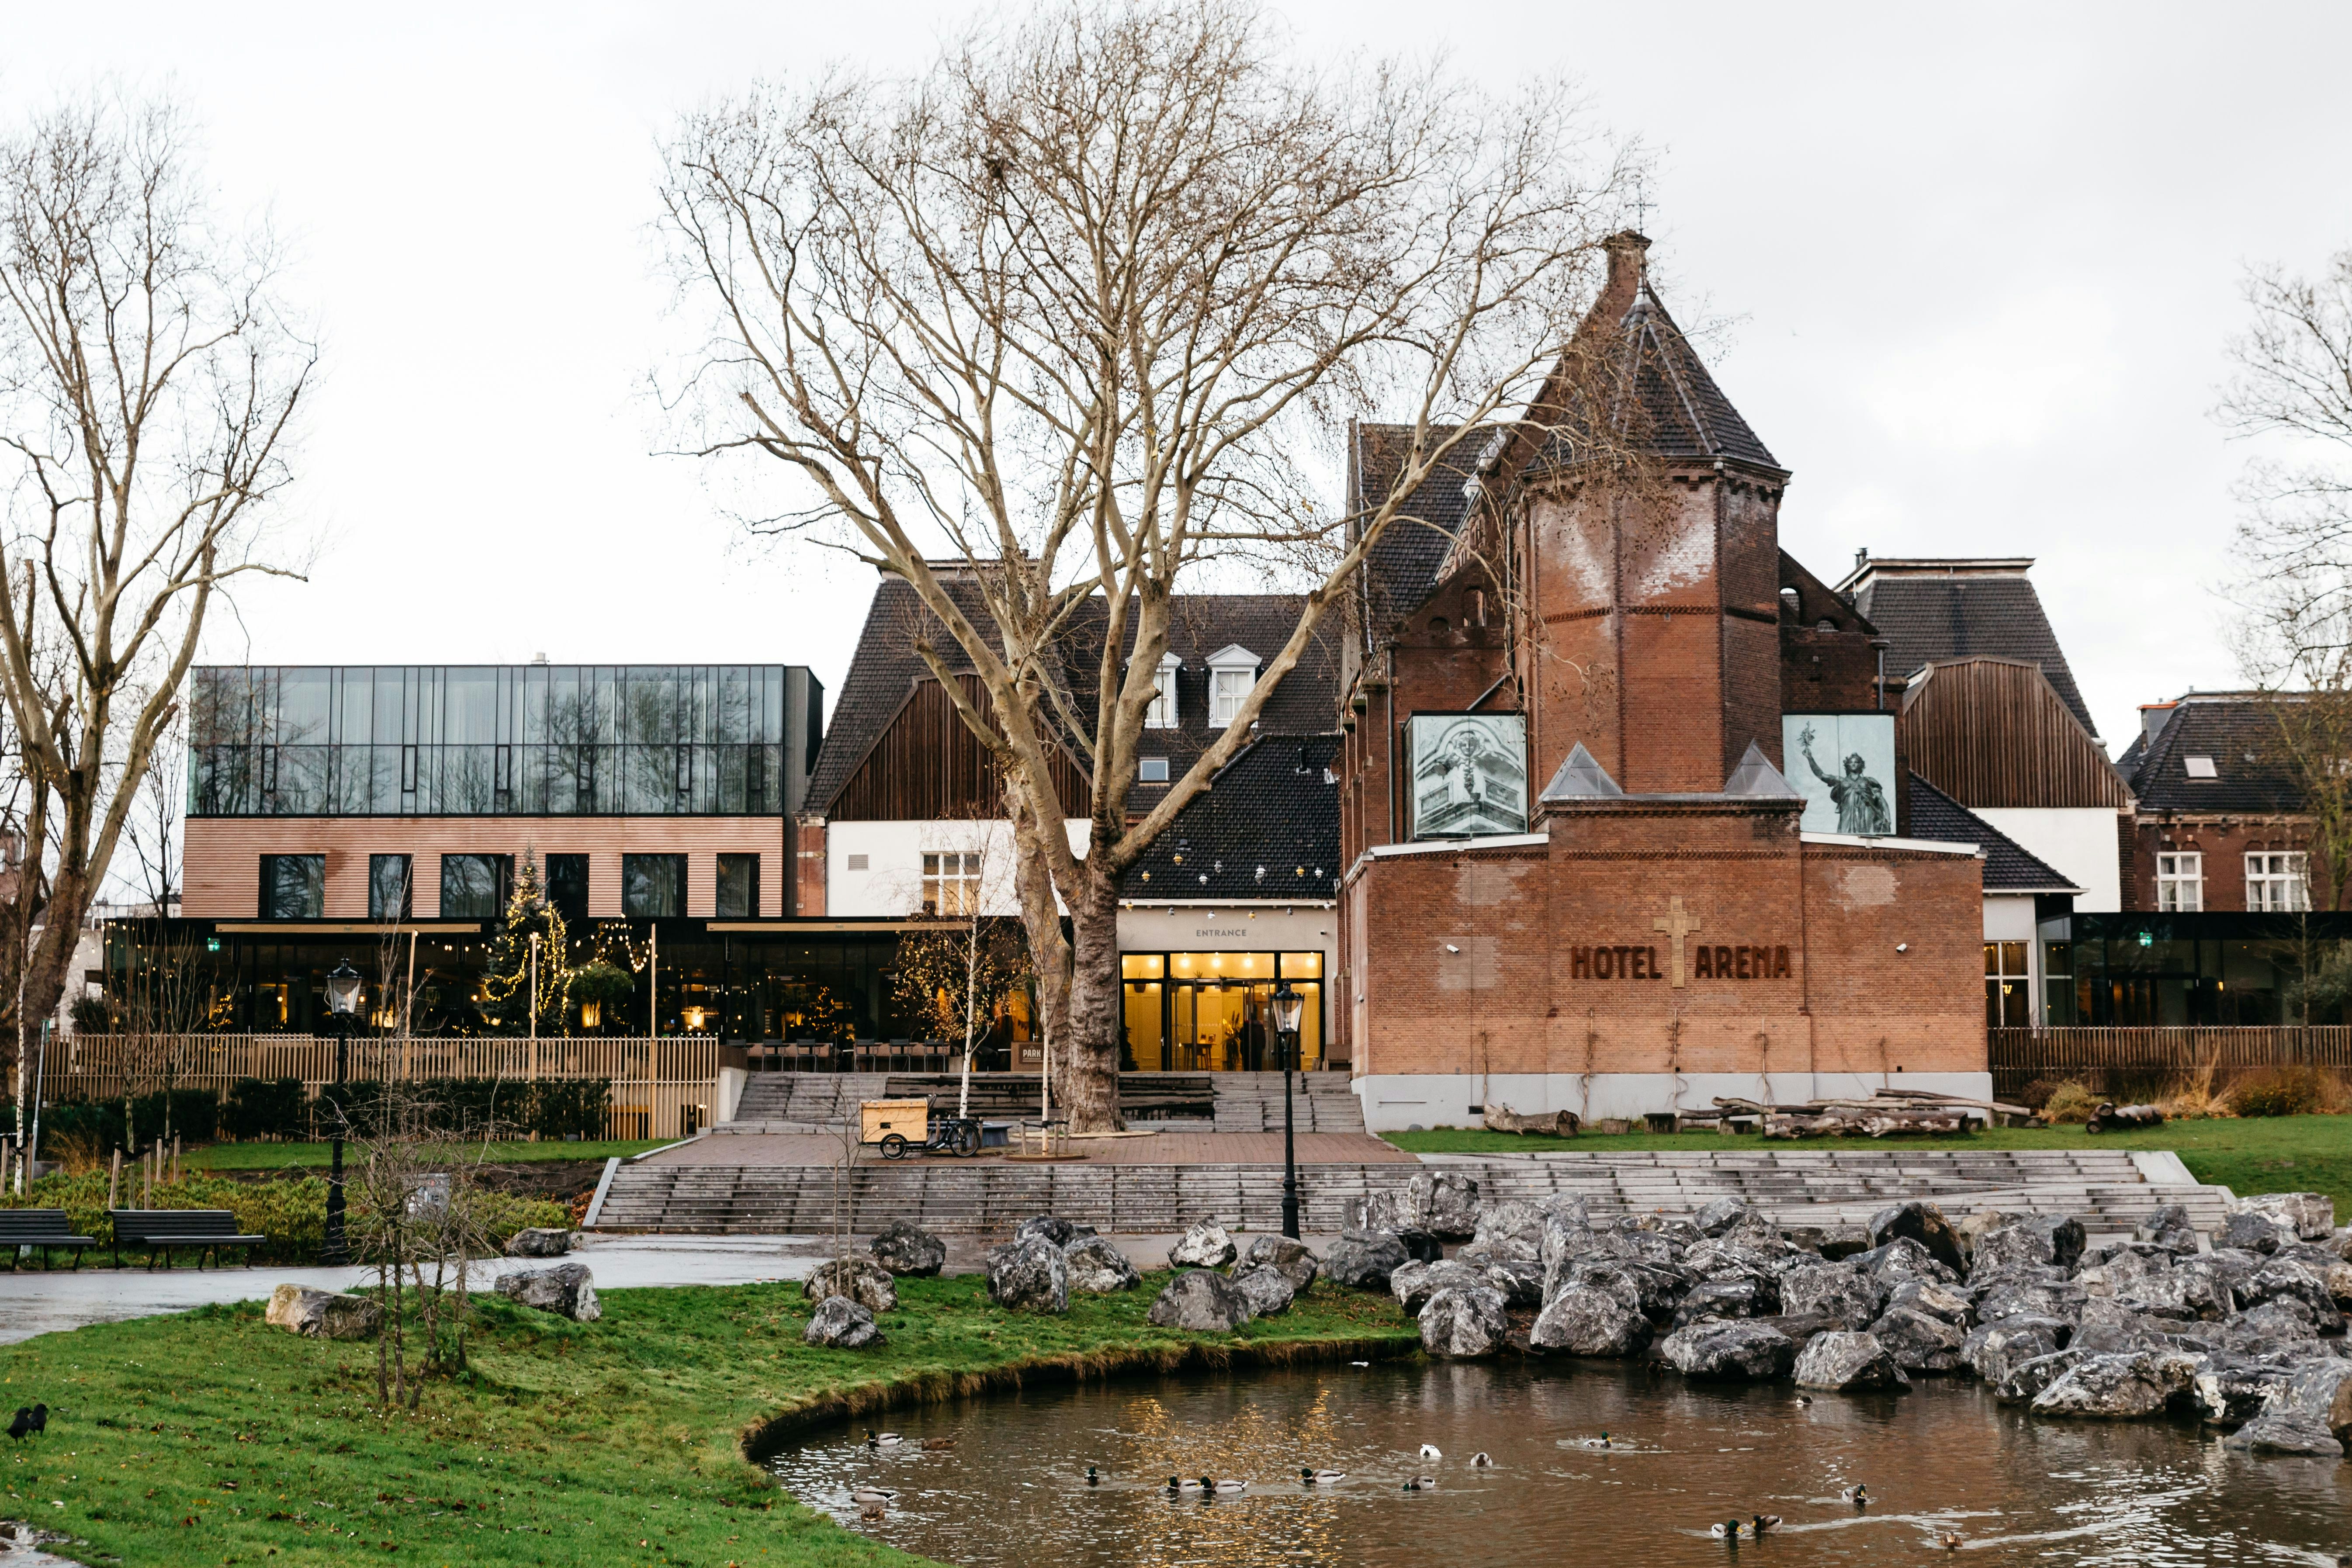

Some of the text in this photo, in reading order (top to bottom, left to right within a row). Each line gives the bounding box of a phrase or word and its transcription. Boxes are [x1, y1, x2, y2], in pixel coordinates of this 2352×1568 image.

[1571, 945, 1791, 979] HOTEL ARENA
[1023, 1049, 1041, 1057] PARK
